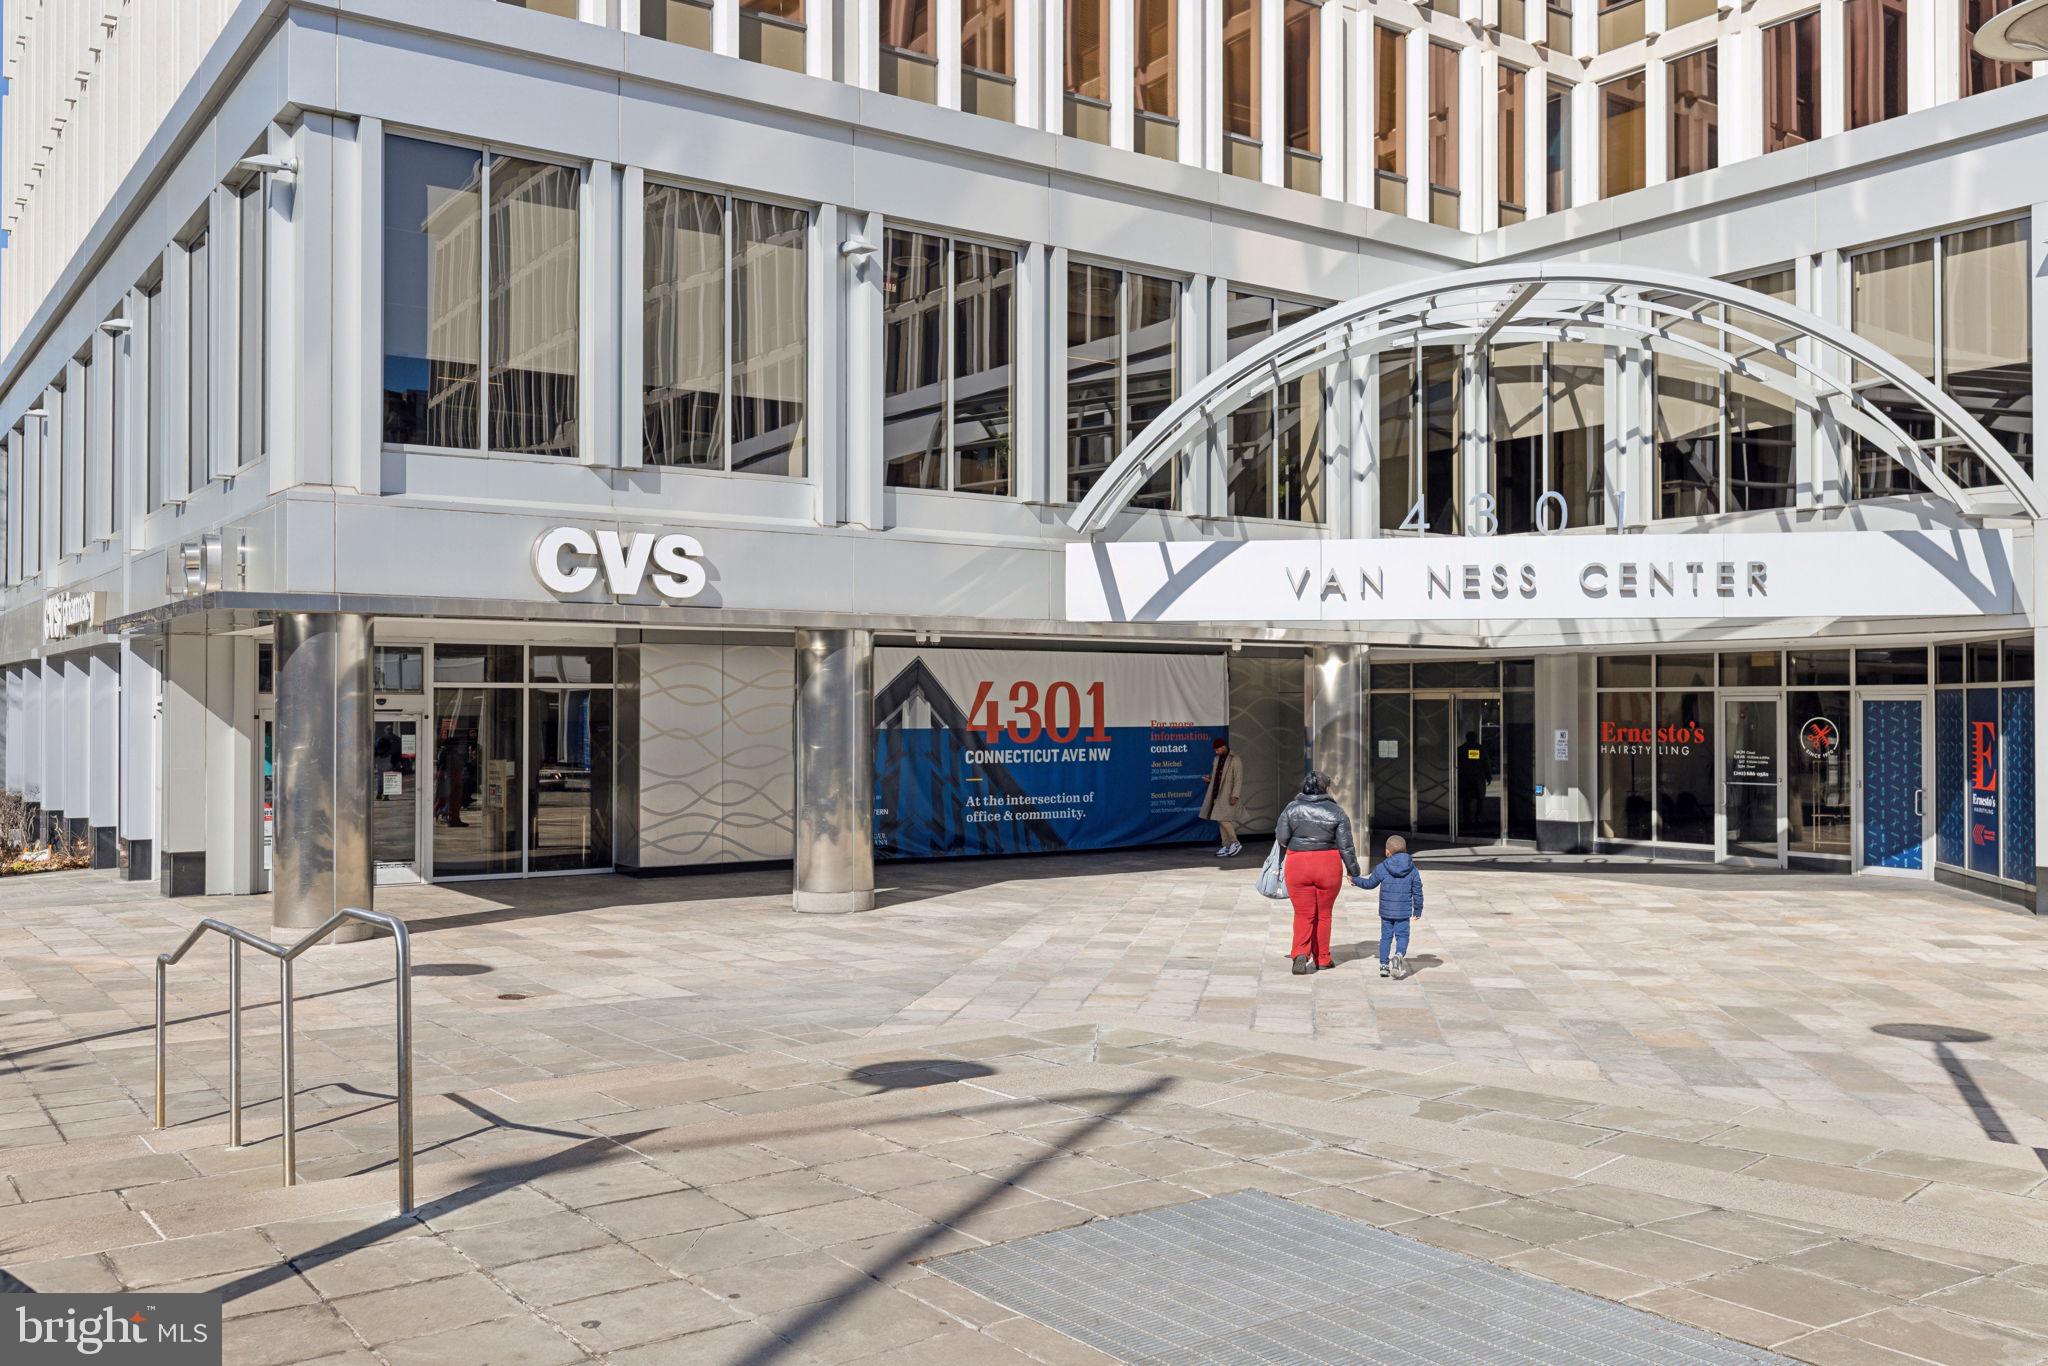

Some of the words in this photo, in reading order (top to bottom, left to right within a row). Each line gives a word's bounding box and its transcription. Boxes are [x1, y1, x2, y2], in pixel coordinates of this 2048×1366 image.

[532, 526, 707, 599] CVS
[1285, 565, 1384, 601] VAN
[1427, 563, 1537, 600] NESS
[1579, 561, 1768, 598] CENTER
[966, 680, 1113, 744] 4301
[1151, 719, 1167, 728] For
[1169, 720, 1195, 729] more
[1601, 721, 1705, 743] Ernesto's
[965, 749, 1059, 764] CONNECTICUT
[1061, 749, 1086, 763] AVE
[1088, 748, 1111, 762] NW
[1150, 744, 1188, 754] contact
[965, 796, 981, 807] At
[983, 794, 1004, 806] the
[1006, 793, 1080, 806] intersection
[1082, 792, 1095, 803] of
[966, 810, 1001, 823] office
[1003, 810, 1014, 821] &
[1015, 807, 1087, 821] community.
